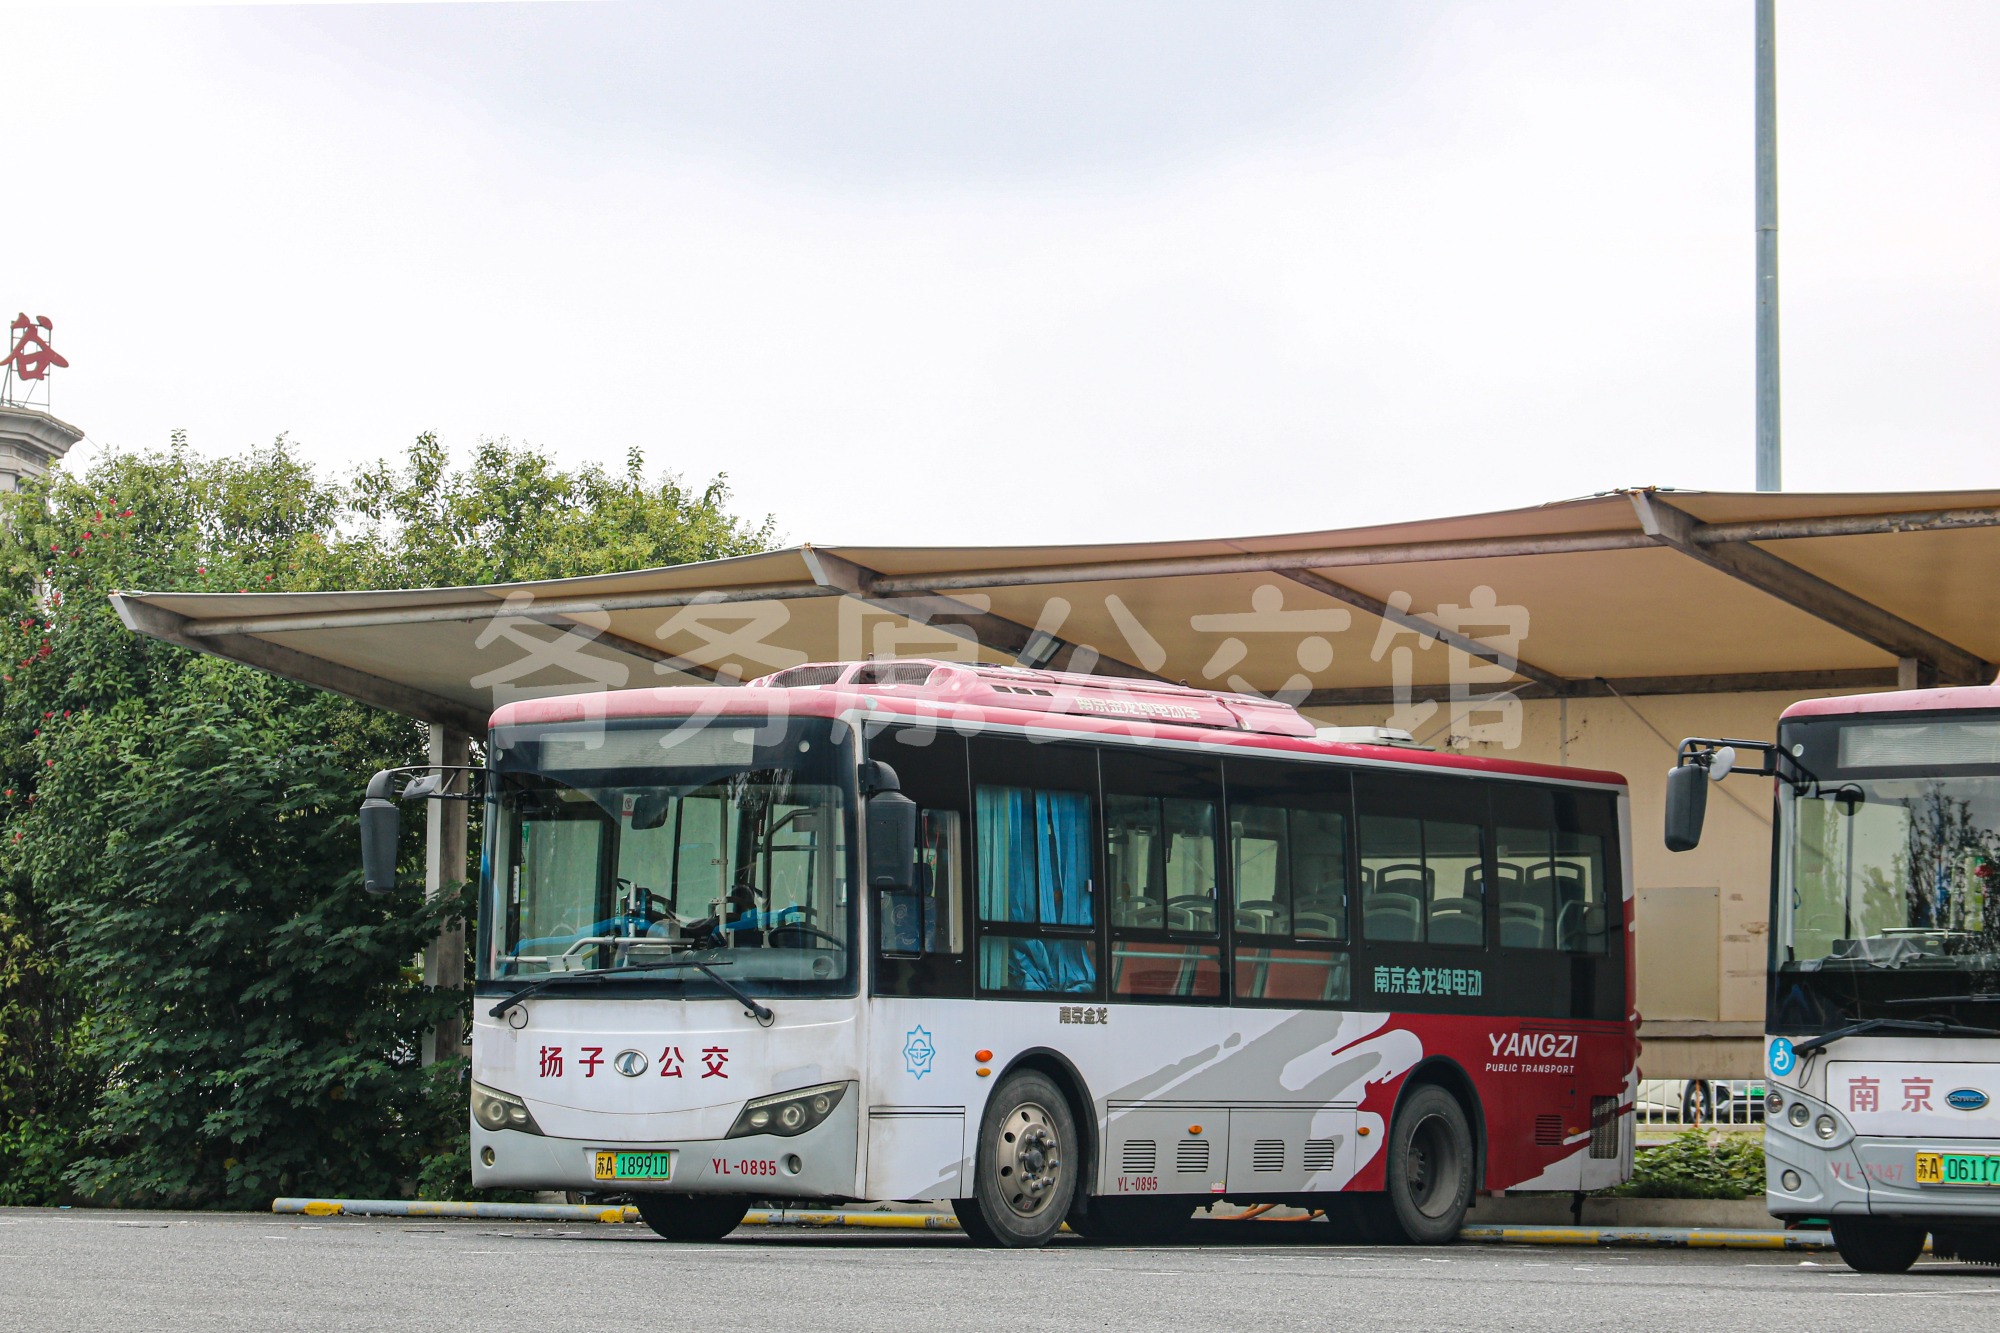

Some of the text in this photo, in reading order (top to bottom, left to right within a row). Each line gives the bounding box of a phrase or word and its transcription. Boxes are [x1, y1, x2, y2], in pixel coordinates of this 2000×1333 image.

[0, 312, 69, 381] 谷
[1374, 965, 1482, 996] 南京金龙纯电动
[1059, 1005, 1108, 1025] 南京金龙
[1488, 1032, 1578, 1058] YANGZI
[539, 1046, 729, 1079] 扬子 公交
[1485, 1063, 1575, 1074] PUBLIC TRANSPORT
[1848, 1076, 1934, 1113] 南京
[620, 1156, 668, 1175] 18991D
[712, 1158, 777, 1176] YL-0895
[1117, 1176, 1158, 1192] YL-0895
